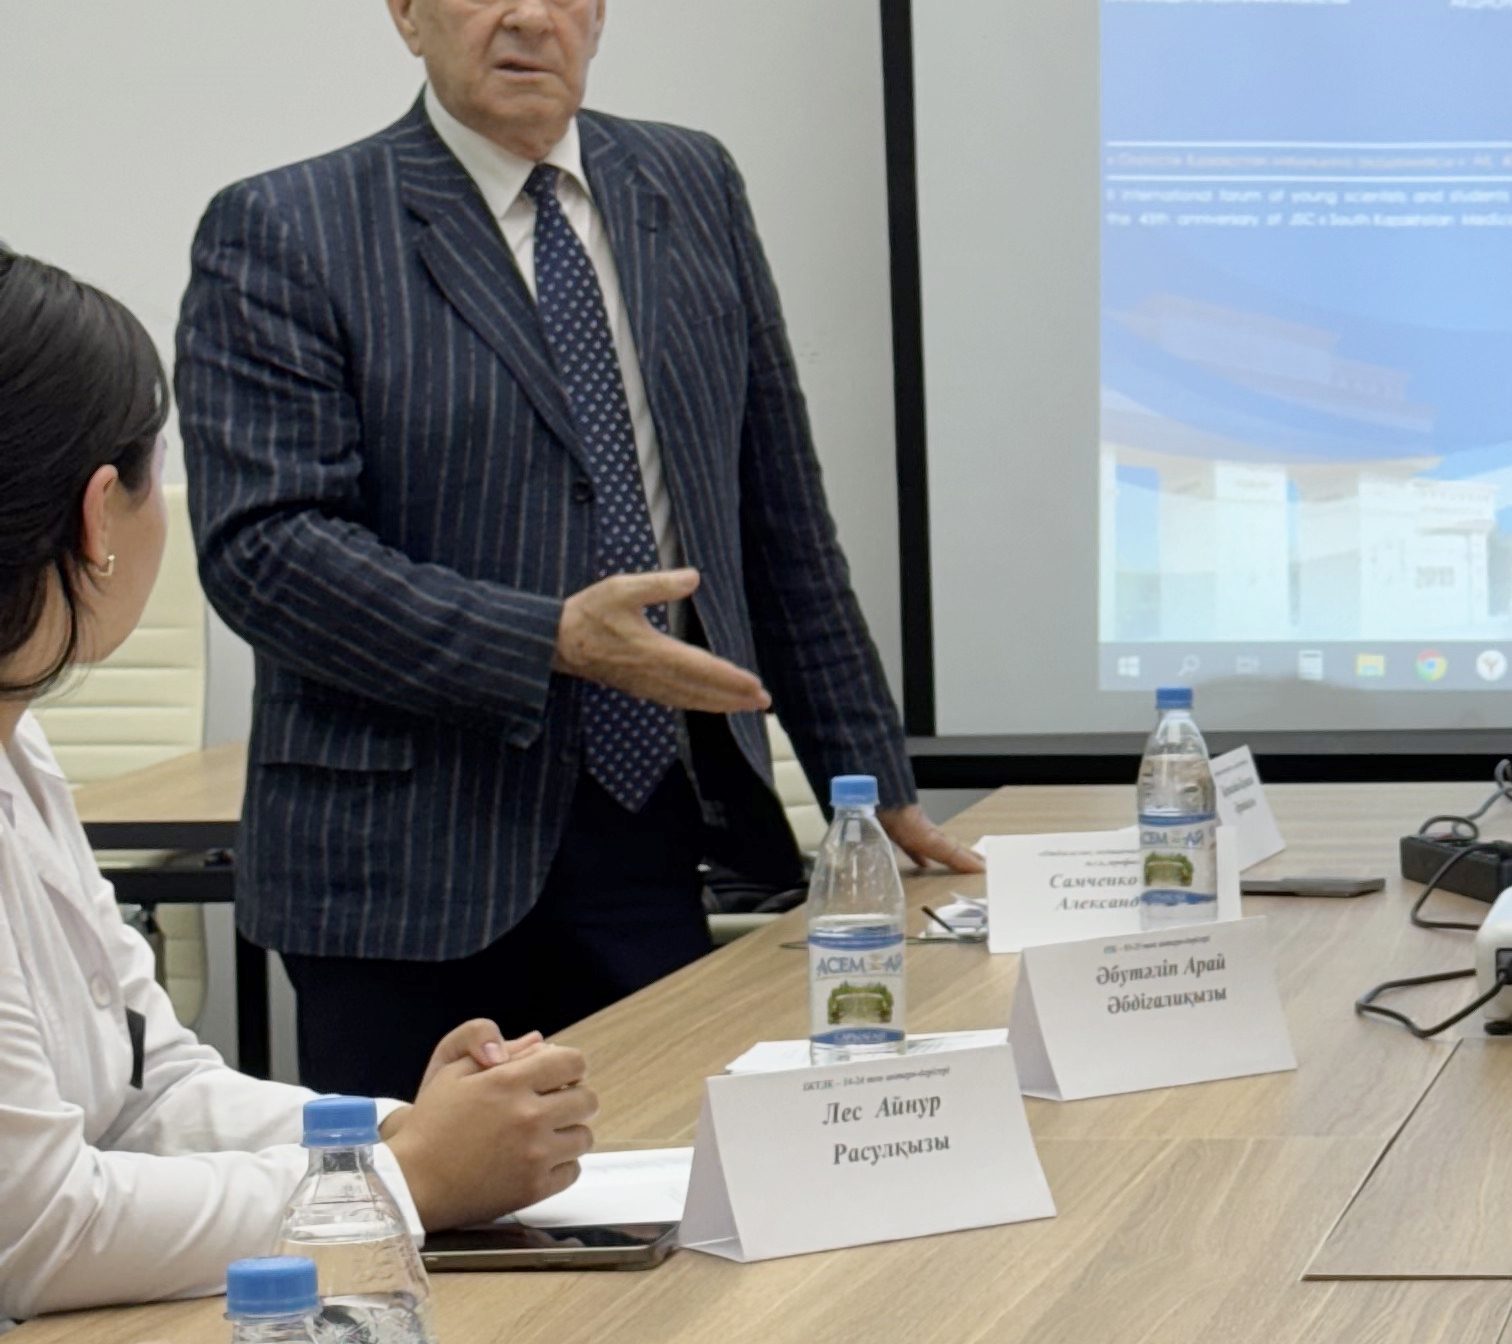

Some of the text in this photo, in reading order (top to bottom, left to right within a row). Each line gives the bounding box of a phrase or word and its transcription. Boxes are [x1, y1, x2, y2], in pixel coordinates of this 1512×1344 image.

[1049, 873, 1138, 888] Самченко
[1056, 895, 1141, 911] Александ
[816, 956, 865, 976] АСЕМ
[1183, 953, 1227, 978] Арай
[822, 1102, 863, 1126] Лес
